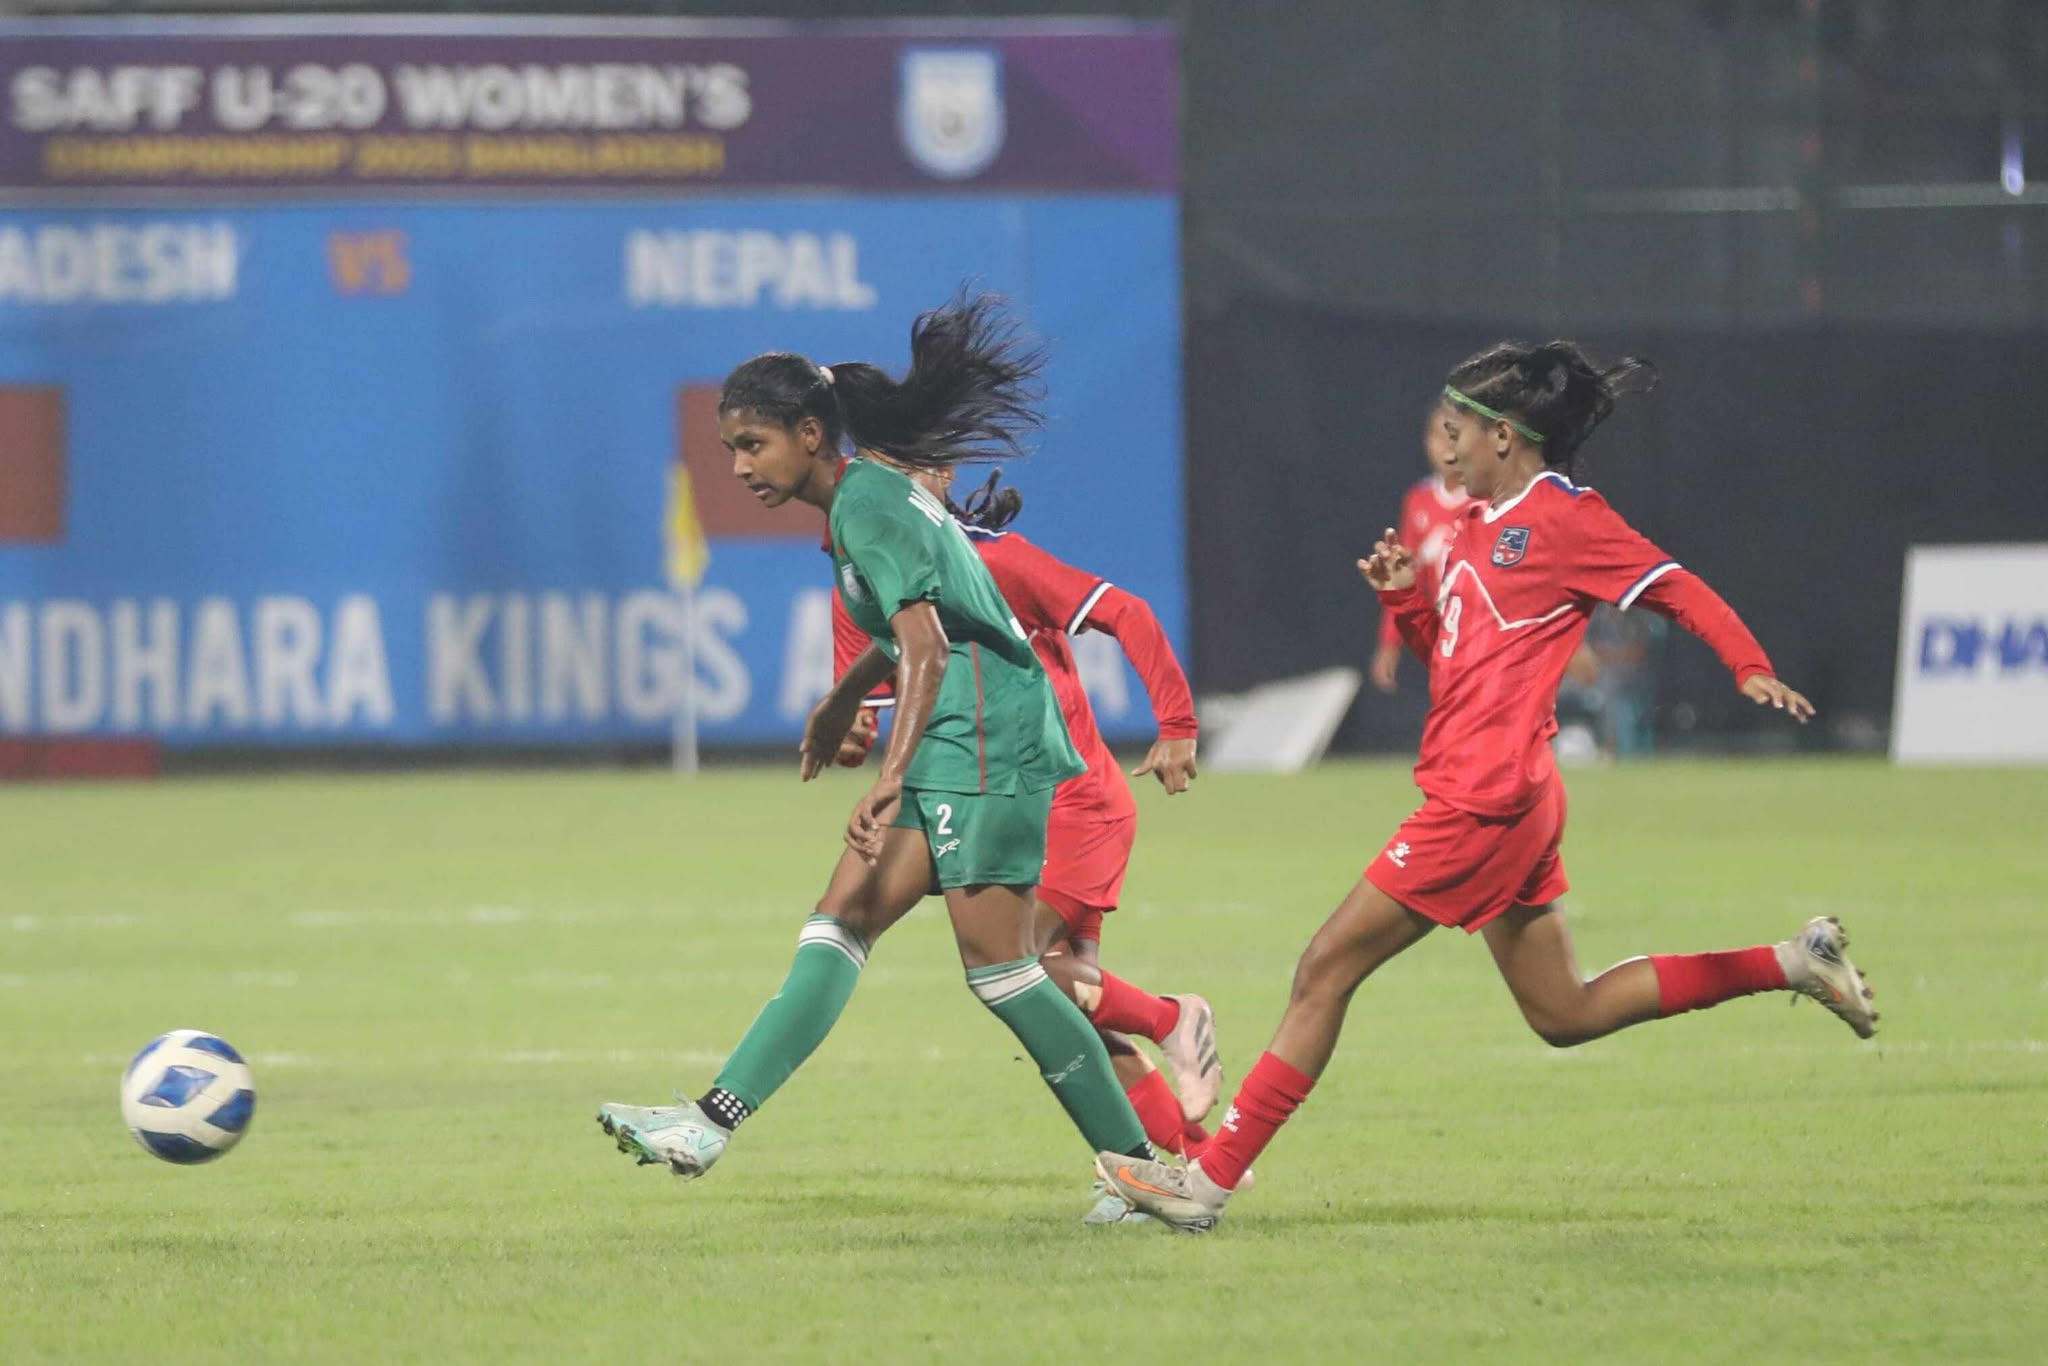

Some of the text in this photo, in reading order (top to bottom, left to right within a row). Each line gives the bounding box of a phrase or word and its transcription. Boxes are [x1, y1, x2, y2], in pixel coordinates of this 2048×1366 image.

[12, 62, 751, 131] SAFF U-20 WOMEN'S
[326, 228, 412, 297] VS
[626, 228, 877, 309] NEPAL
[424, 590, 750, 726] KINGS
[936, 803, 953, 835] 2
